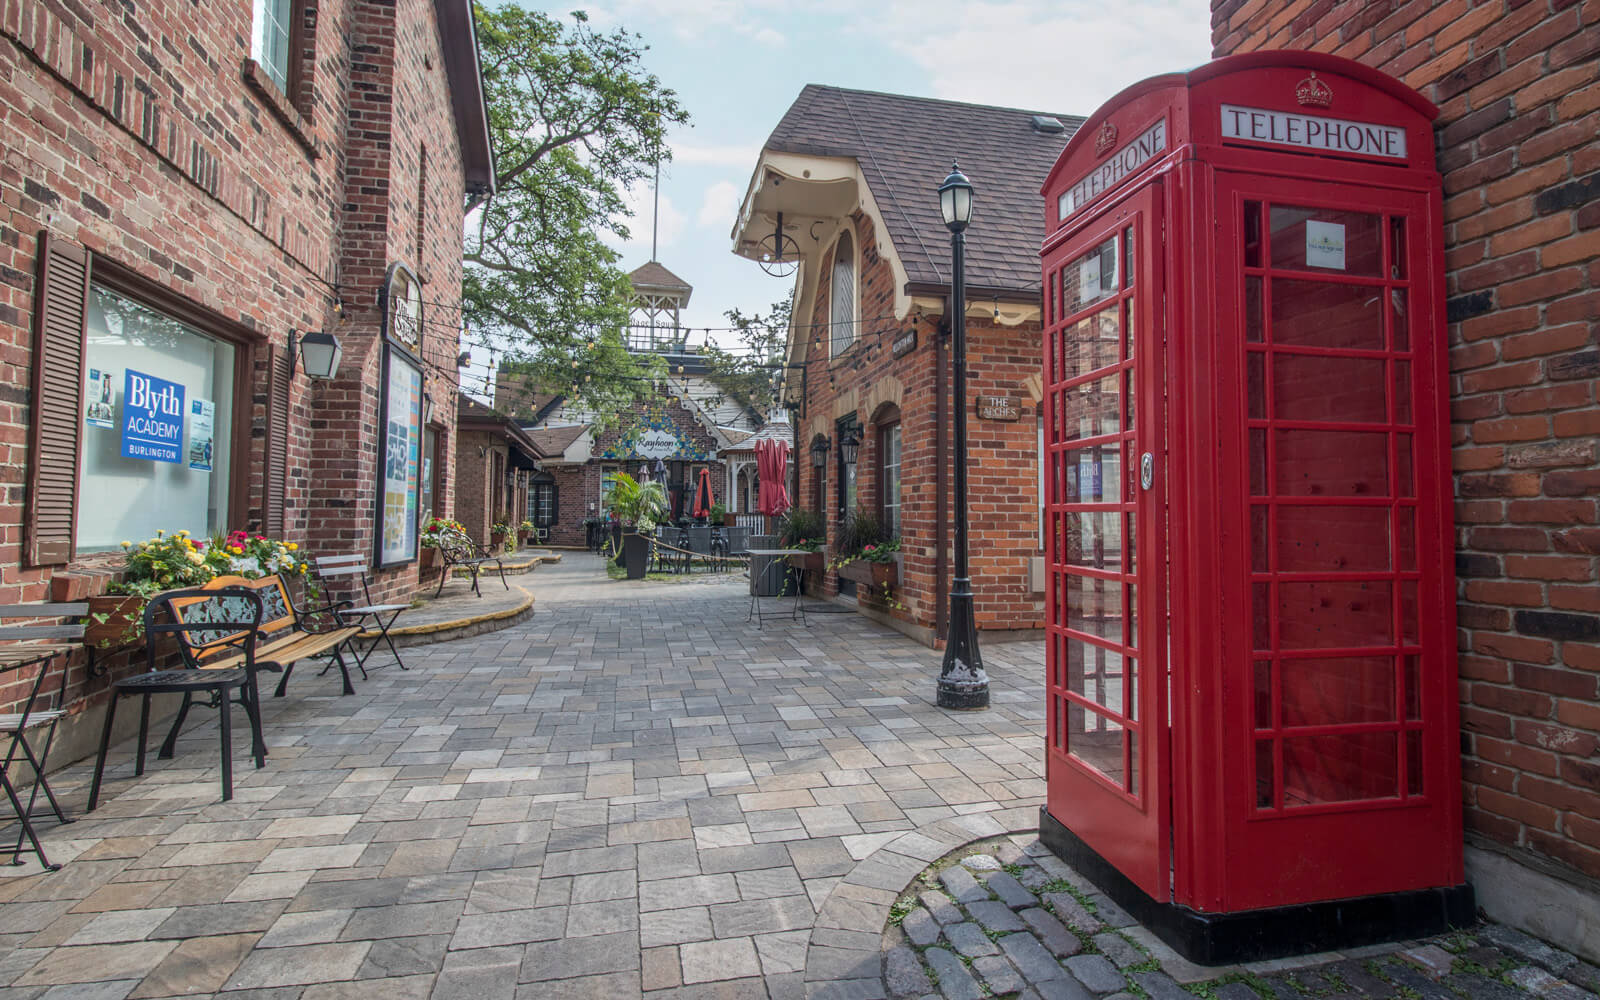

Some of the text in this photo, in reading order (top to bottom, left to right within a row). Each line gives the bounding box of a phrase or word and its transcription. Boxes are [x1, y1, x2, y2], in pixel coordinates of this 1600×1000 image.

[1228, 109, 1400, 156] TELEPHONE
[128, 375, 180, 418] Blyth
[991, 397, 1009, 407] THE
[983, 407, 1017, 417] ARCHES
[127, 416, 180, 439] ACADEMY
[129, 444, 177, 459] BURLINGTON
[638, 436, 674, 452] Rayhoon
